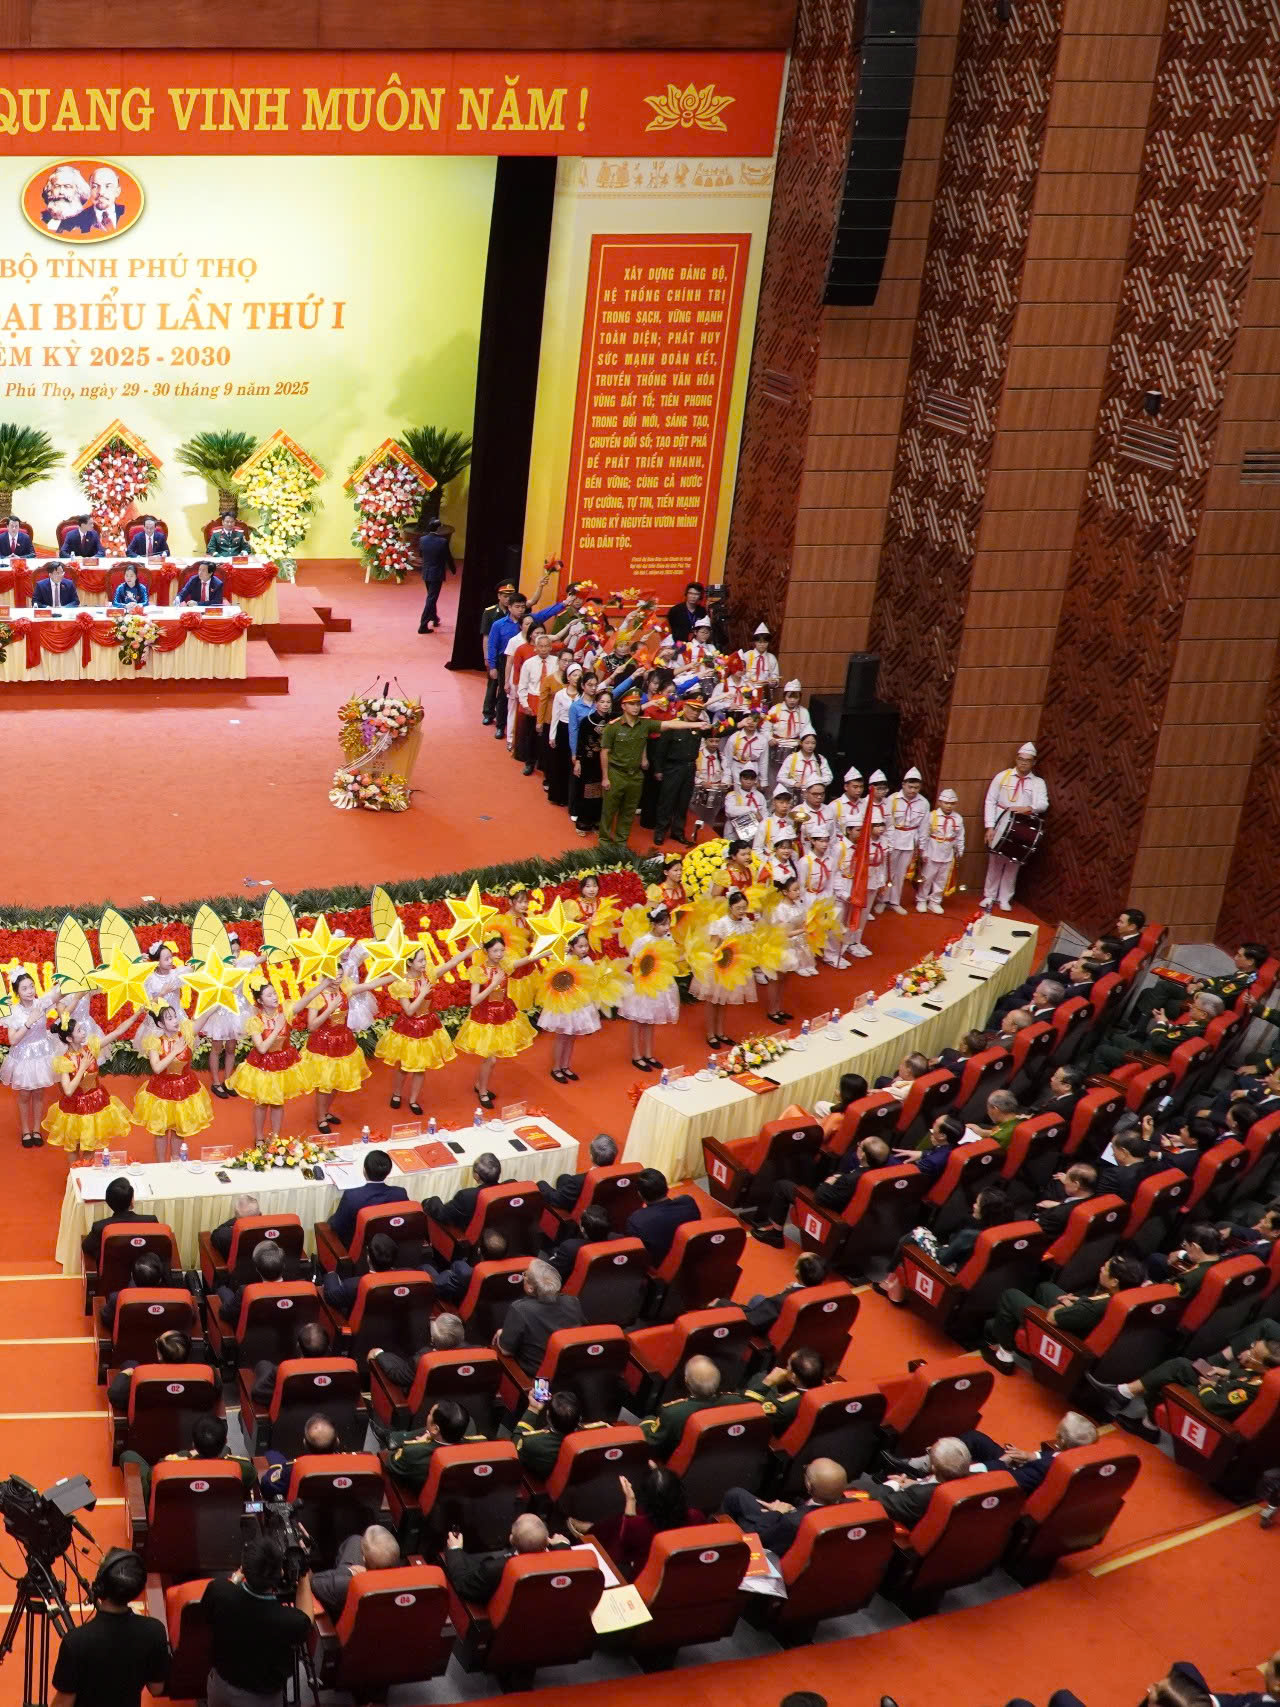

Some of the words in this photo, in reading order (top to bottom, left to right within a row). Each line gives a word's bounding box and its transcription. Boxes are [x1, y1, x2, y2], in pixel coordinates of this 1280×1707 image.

[168, 88, 290, 130] VINH
[301, 73, 445, 131] MUÔN
[457, 75, 568, 130] NĂM
[0, 251, 38, 284] BỘ
[47, 251, 118, 279] TỈNH
[129, 253, 188, 279] PHÚ
[197, 257, 257, 283] THỌ
[54, 288, 146, 331] BIỂU
[157, 289, 231, 330] LẦN
[243, 293, 324, 330] THỨ
[330, 302, 346, 329] I
[602, 311, 631, 324] TRONG
[700, 332, 720, 344] HUY
[43, 342, 81, 367] KỲ
[89, 346, 151, 367] 2025
[171, 345, 231, 367] 2030
[5, 382, 36, 398] Phú
[43, 381, 75, 400] Thọ,
[80, 384, 118, 400] ngày
[121, 383, 140, 397] 29
[153, 383, 170, 397] 30
[175, 381, 219, 400] tháng
[224, 382, 234, 397] 9
[238, 382, 271, 396] năm
[274, 382, 310, 396] 2025
[684, 394, 713, 407] PHONG
[591, 415, 618, 428] TRONG
[581, 517, 608, 529] TRONG
